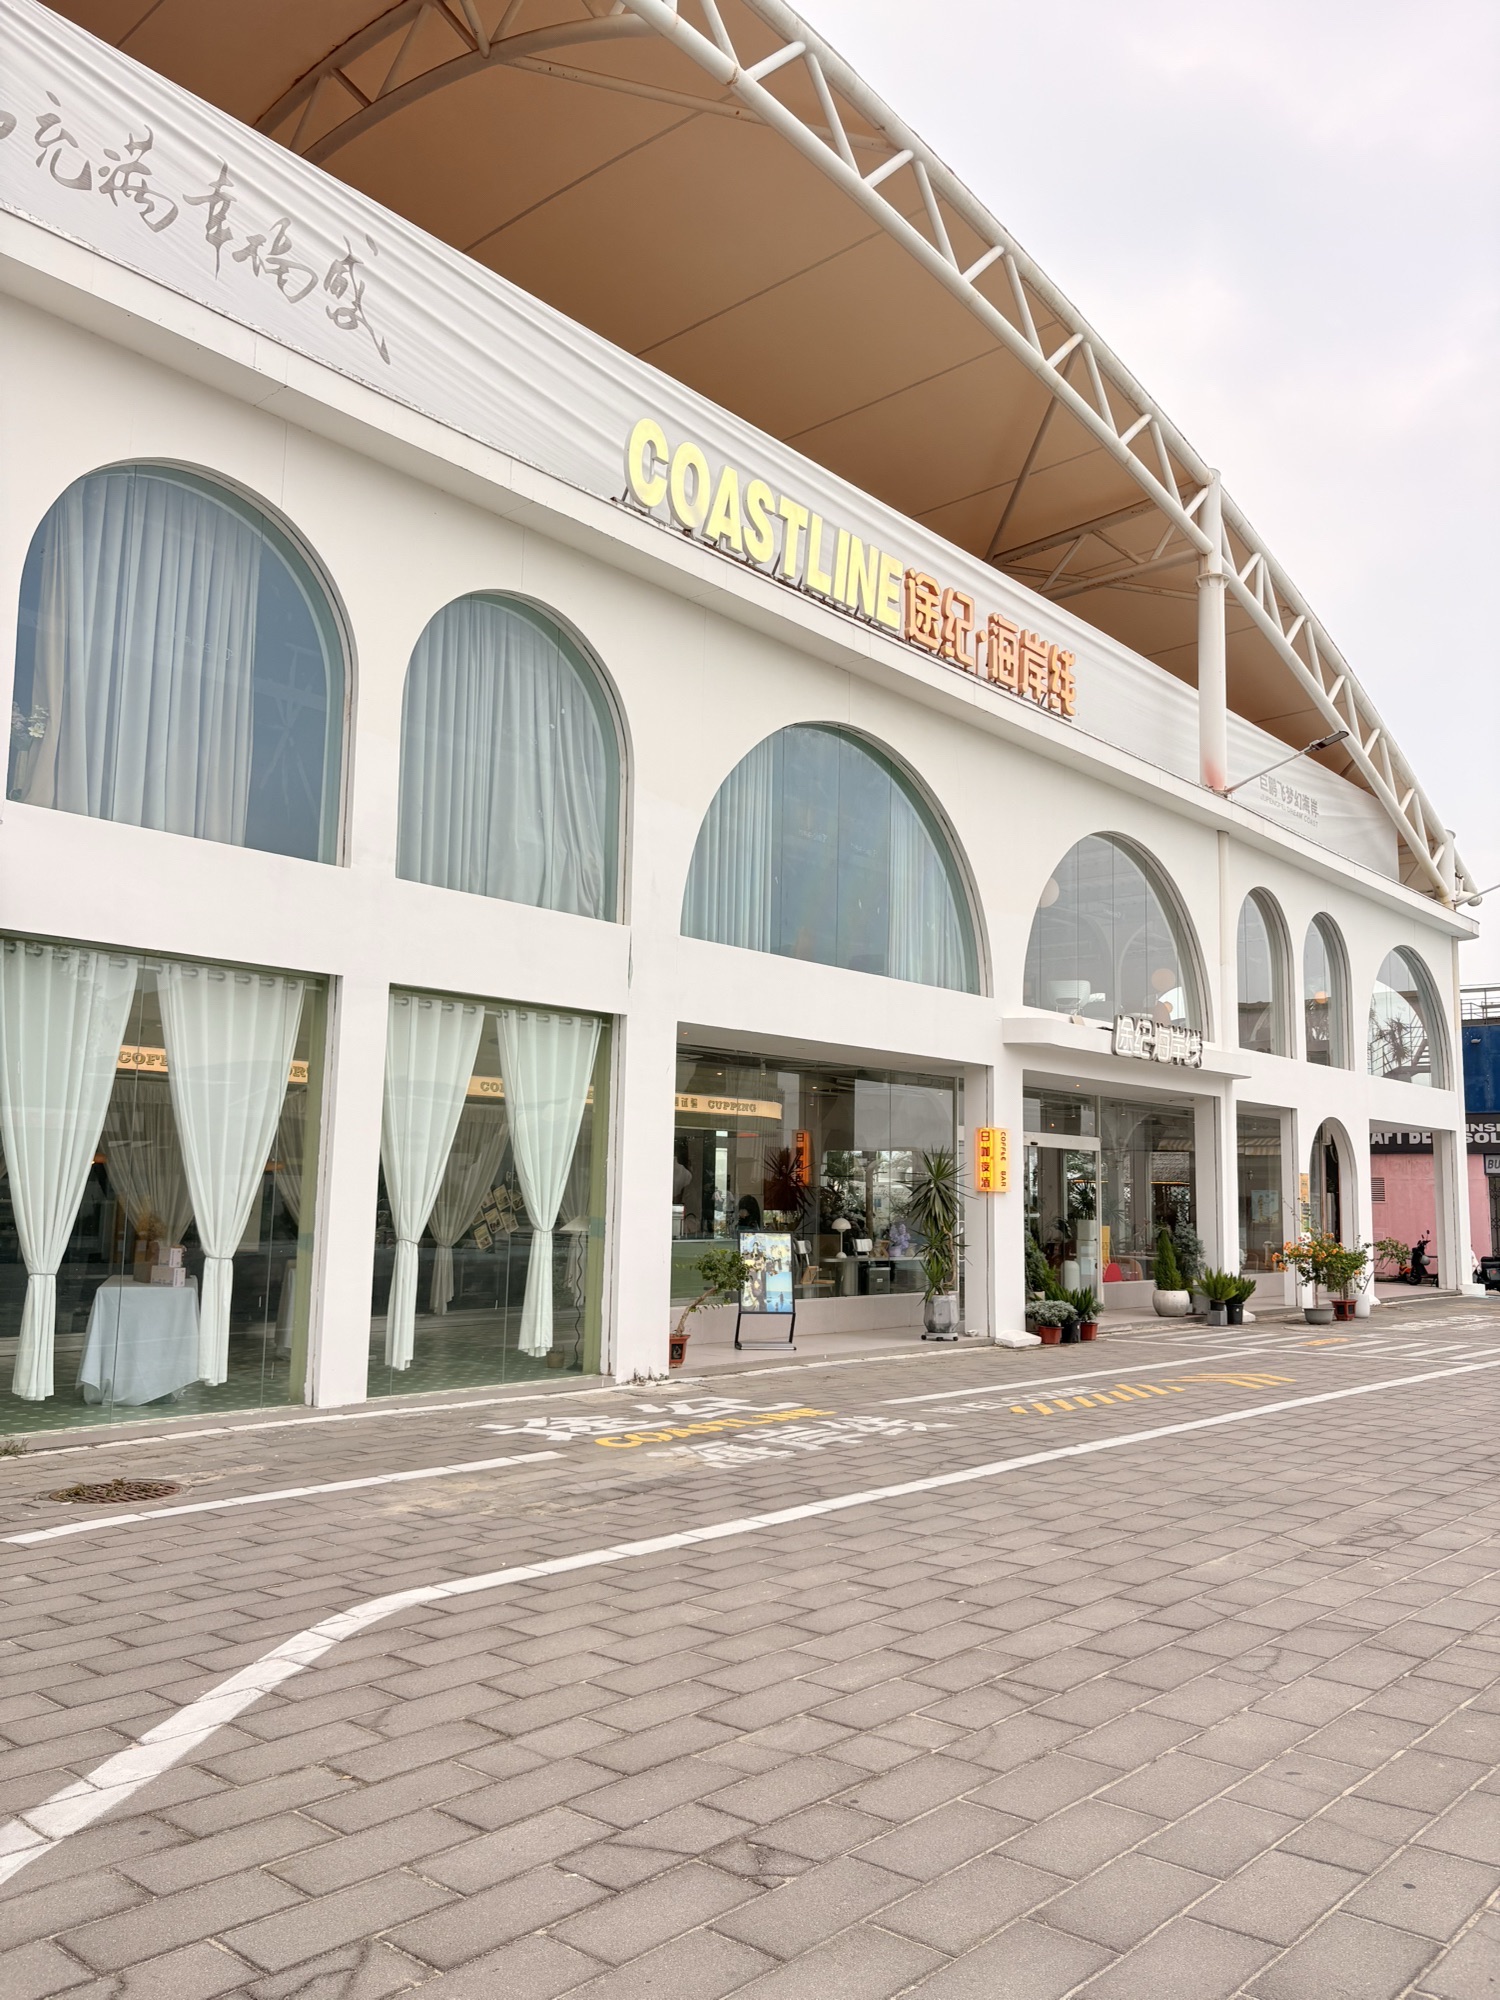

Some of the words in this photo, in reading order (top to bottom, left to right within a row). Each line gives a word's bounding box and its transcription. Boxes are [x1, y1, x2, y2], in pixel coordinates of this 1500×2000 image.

[624, 417, 903, 631] COASTLINE
[1303, 815, 1319, 829] COAST
[708, 1100, 757, 1112] CUPPING
[593, 1408, 838, 1449] COASTLINE
